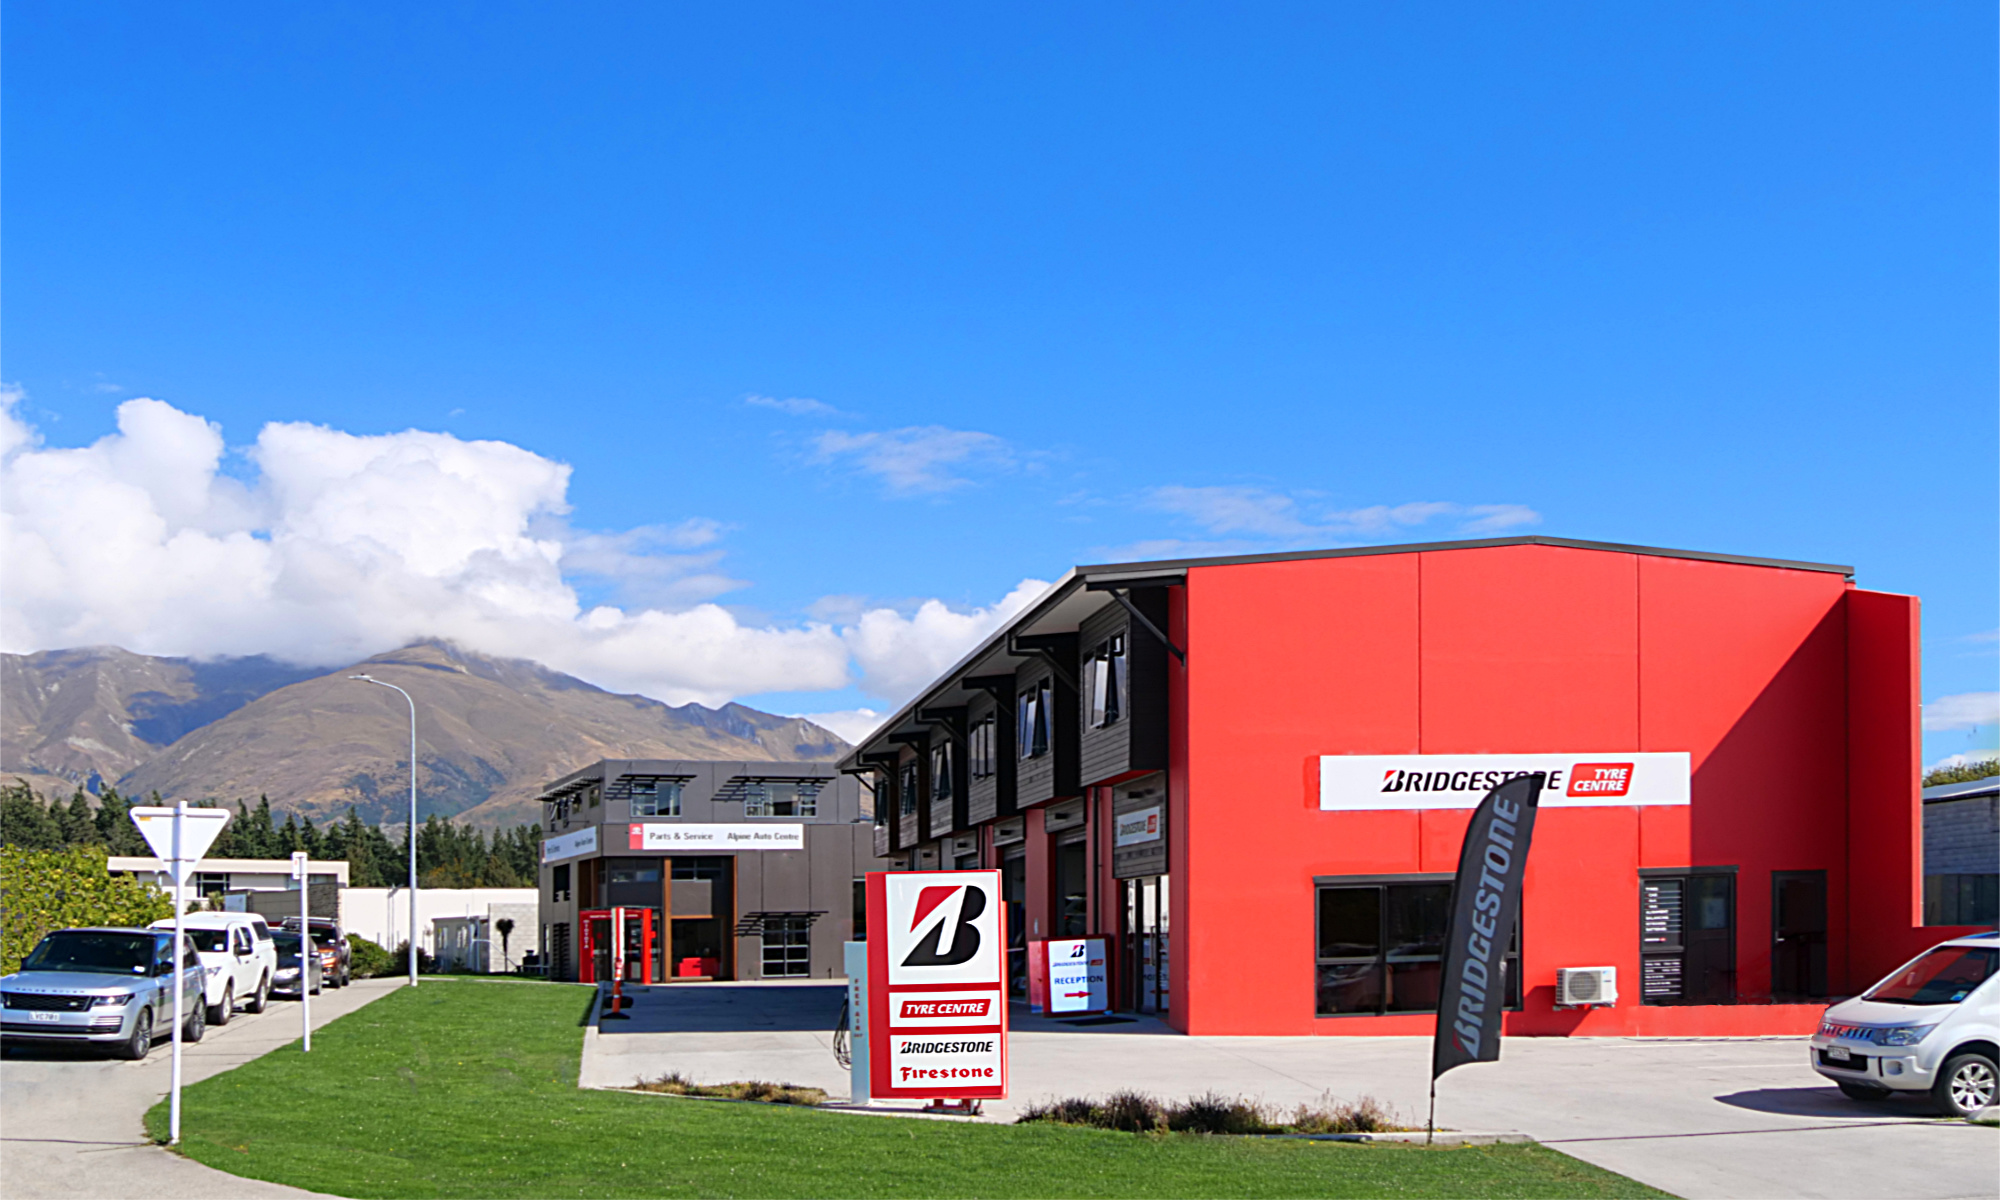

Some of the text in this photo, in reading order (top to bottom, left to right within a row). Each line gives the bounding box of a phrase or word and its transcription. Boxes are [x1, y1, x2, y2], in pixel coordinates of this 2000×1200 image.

[1595, 768, 1627, 780] TYRE
[1381, 770, 1563, 793] BRIDGESTE
[1573, 780, 1624, 792] CENTRE
[649, 832, 714, 840] Parts & Service
[727, 832, 800, 842] Alpine Auto Centre
[1452, 794, 1520, 1060] BRIDGESTONE
[1054, 975, 1103, 984] RECEPTION
[906, 1003, 985, 1015] TYRE CENTRE
[900, 1041, 994, 1054] BRIDGESTONE
[900, 1066, 994, 1082] Firestone
